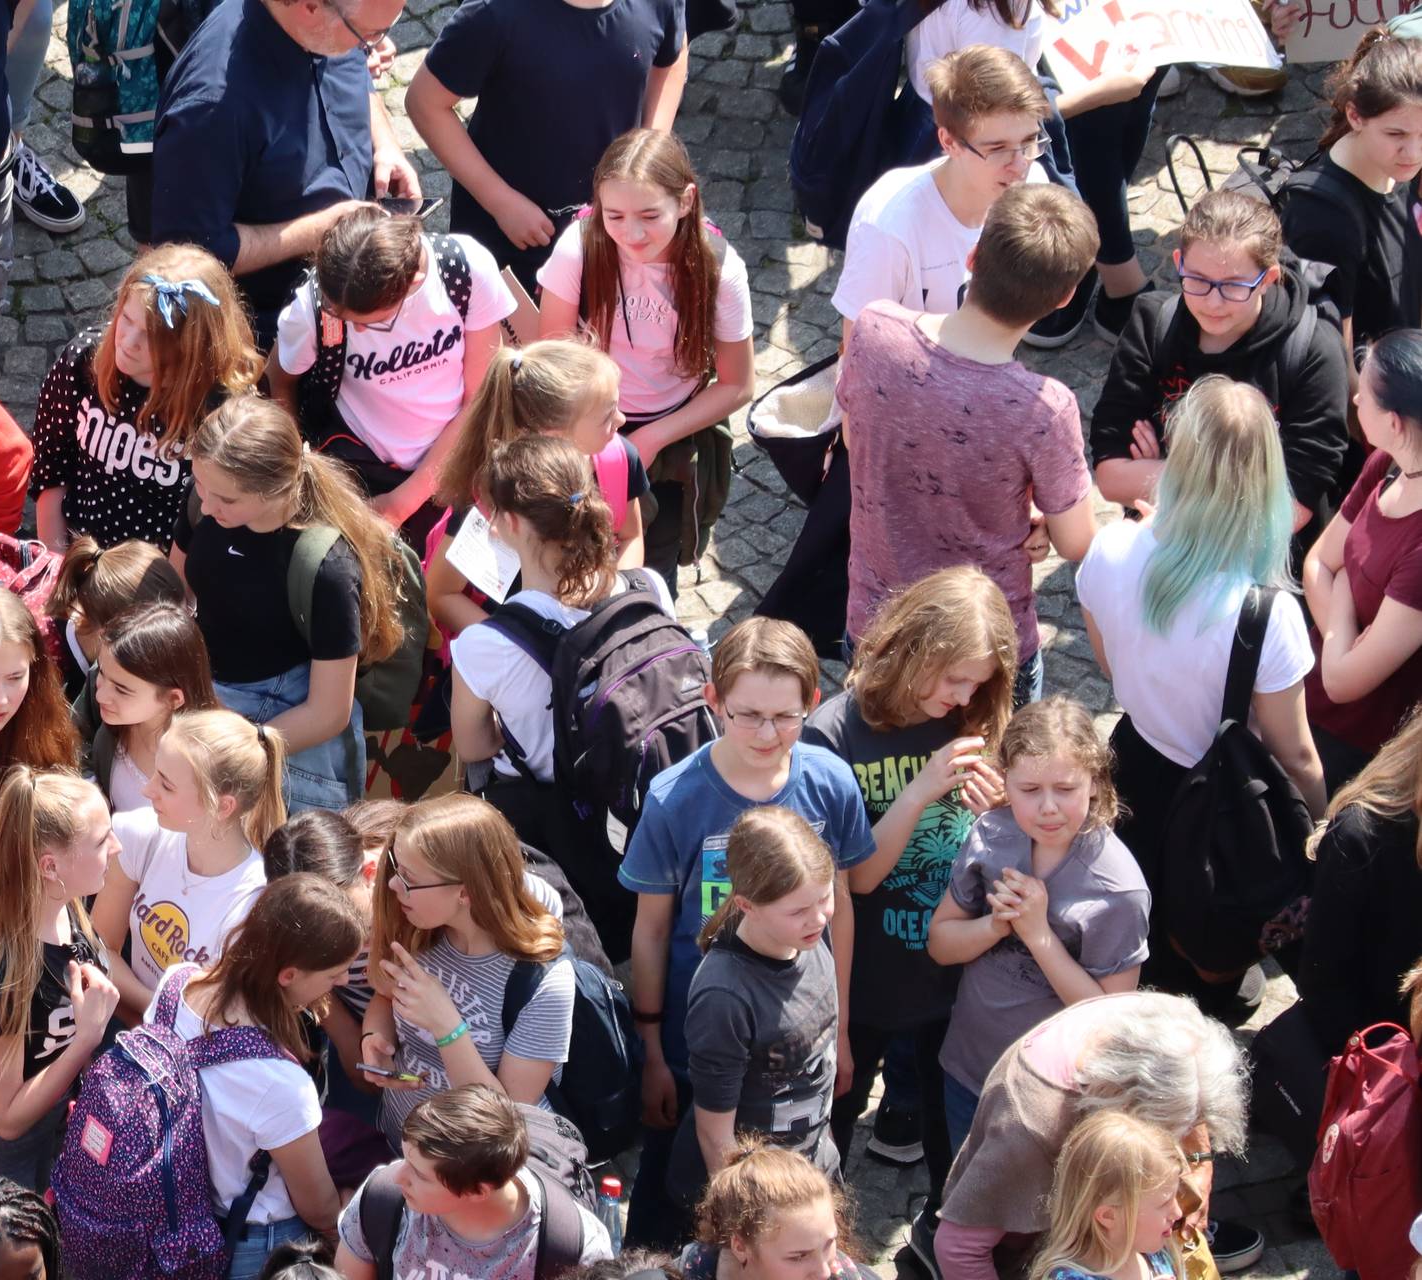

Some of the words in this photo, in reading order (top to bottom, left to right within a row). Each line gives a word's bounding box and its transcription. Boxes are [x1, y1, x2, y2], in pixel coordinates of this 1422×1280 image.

[347, 325, 462, 380] Hollister
[379, 358, 449, 385] CALIFORNIA
[882, 873, 918, 891] SURF
[167, 925, 210, 967] Rock
